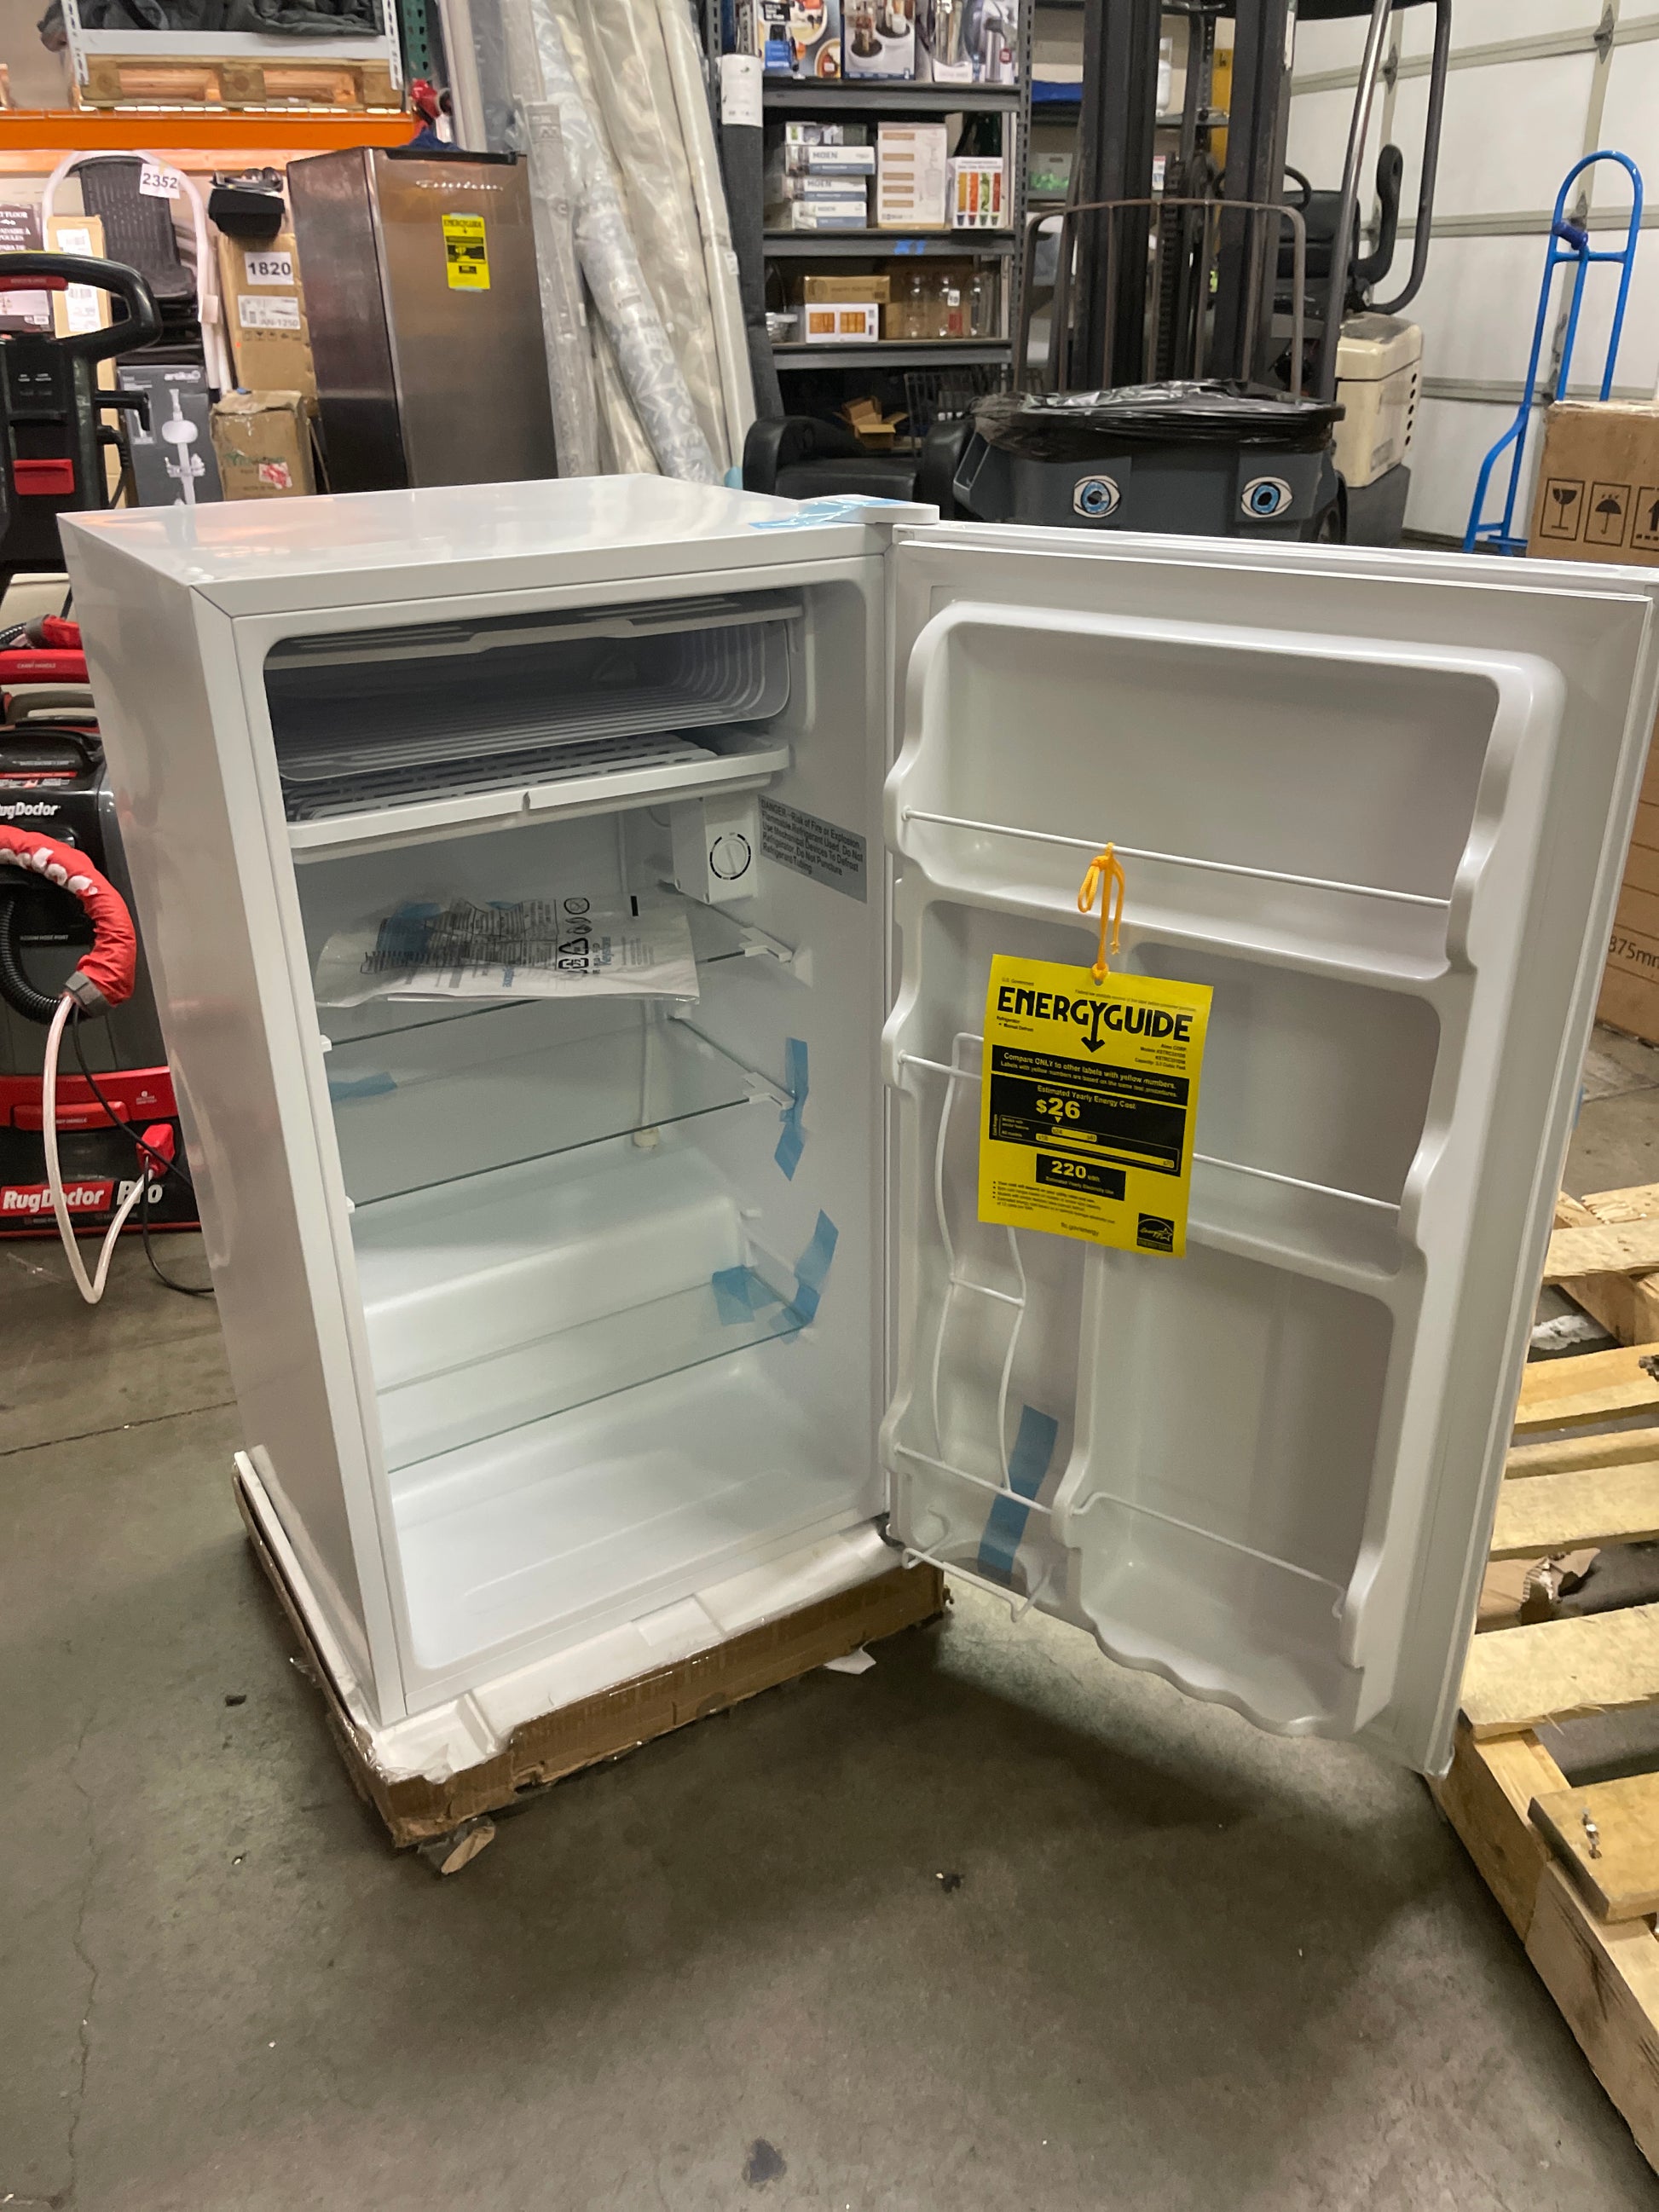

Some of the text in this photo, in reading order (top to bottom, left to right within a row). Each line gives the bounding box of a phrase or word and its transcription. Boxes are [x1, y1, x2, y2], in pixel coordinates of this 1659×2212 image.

[812, 151, 838, 159] MOEN
[142, 173, 177, 189] 2352
[807, 179, 832, 188] MOEN
[248, 262, 292, 275] 1820
[0, 801, 58, 820] ugDoctor
[811, 820, 823, 834] Fire
[817, 855, 842, 876] Puncture
[836, 853, 859, 872] Defrost
[997, 985, 1193, 1042] ENERGYGUIDE
[1000, 1060, 1018, 1069] Labels
[1003, 1052, 1034, 1064] Compare
[1035, 1058, 1054, 1067] ONLY
[1063, 1064, 1081, 1072] other
[1082, 1066, 1102, 1077] labels
[1103, 1071, 1119, 1079] with
[1119, 1074, 1142, 1083] yellow
[1037, 1085, 1136, 1110] Estimated Yearly Energy Cost
[1036, 1097, 1081, 1120] $26
[1051, 1160, 1087, 1179] 220
[3, 1187, 104, 1213] RugDctor
